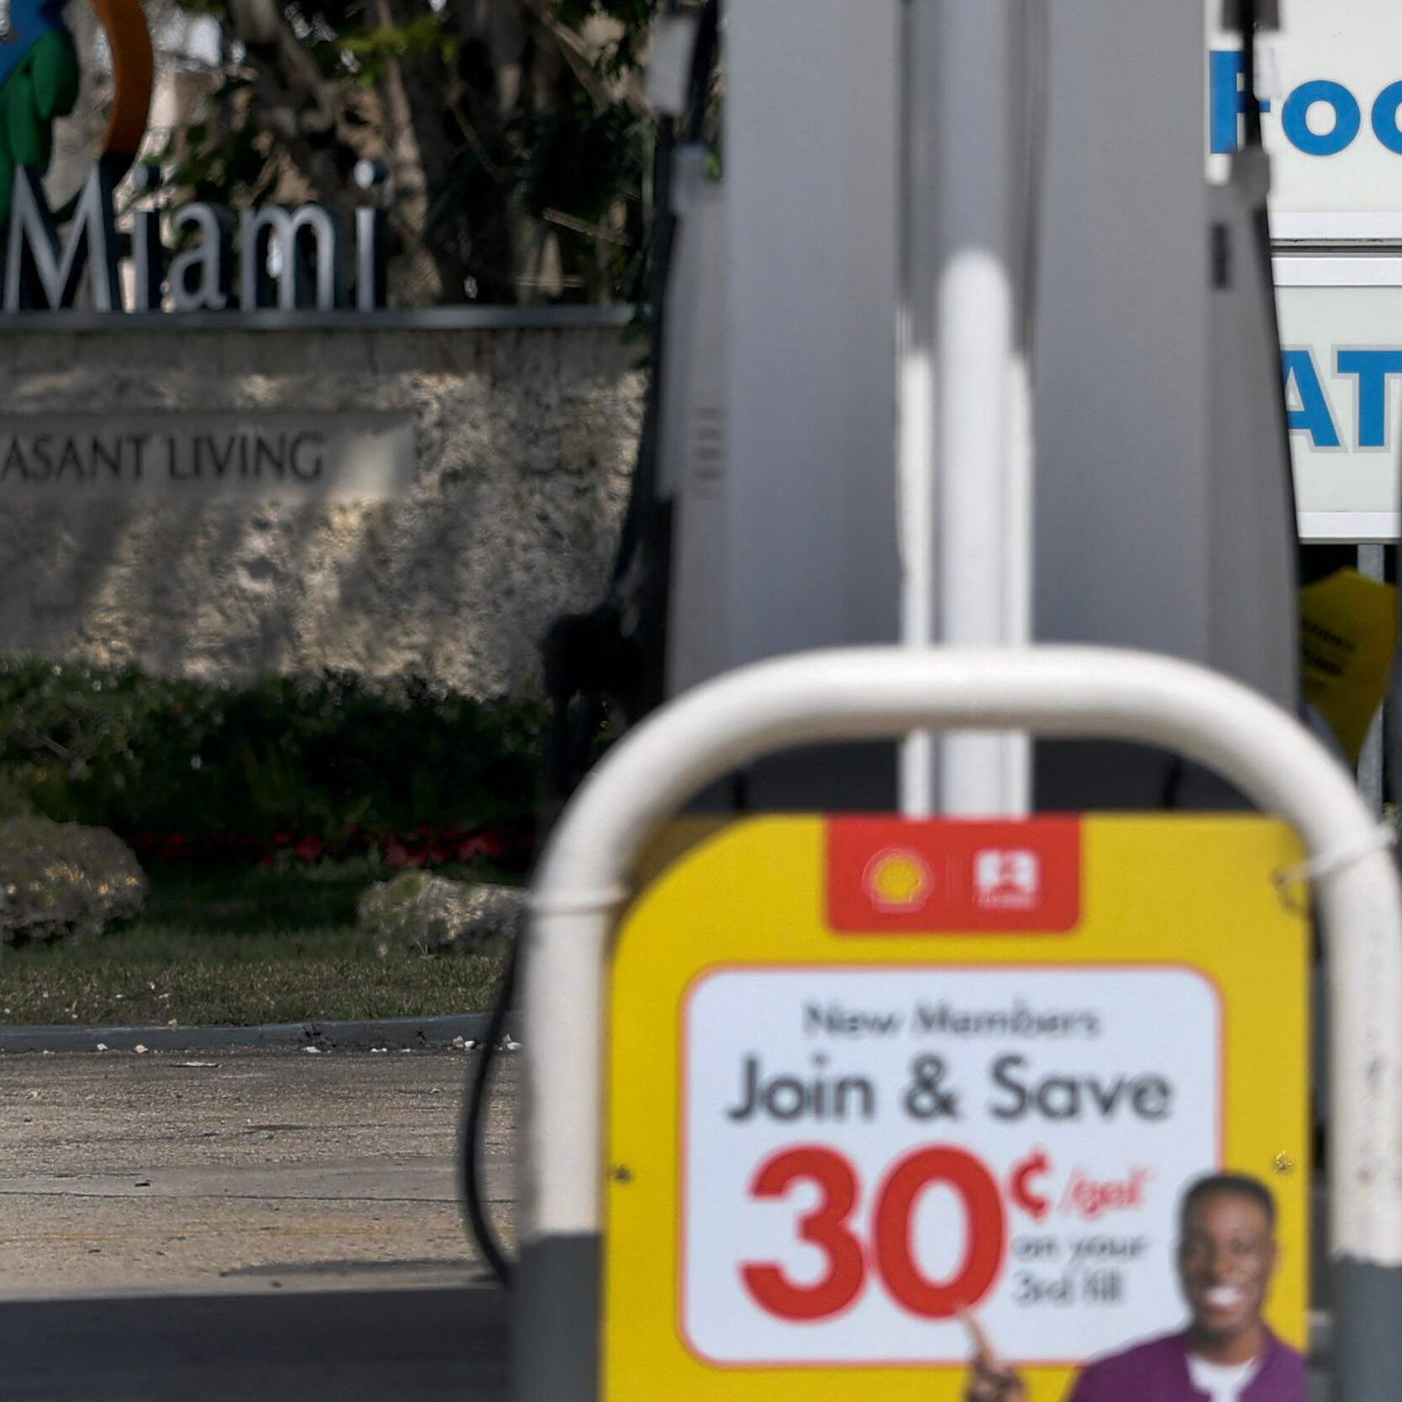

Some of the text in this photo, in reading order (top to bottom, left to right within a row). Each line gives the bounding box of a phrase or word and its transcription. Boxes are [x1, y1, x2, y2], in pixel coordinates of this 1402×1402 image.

[4, 158, 379, 313] Miami
[2, 434, 324, 482] ASANT LIVING
[803, 1000, 1102, 1039] New Members
[724, 1052, 1174, 1125] Join & Save
[1012, 1234, 1148, 1272] on your
